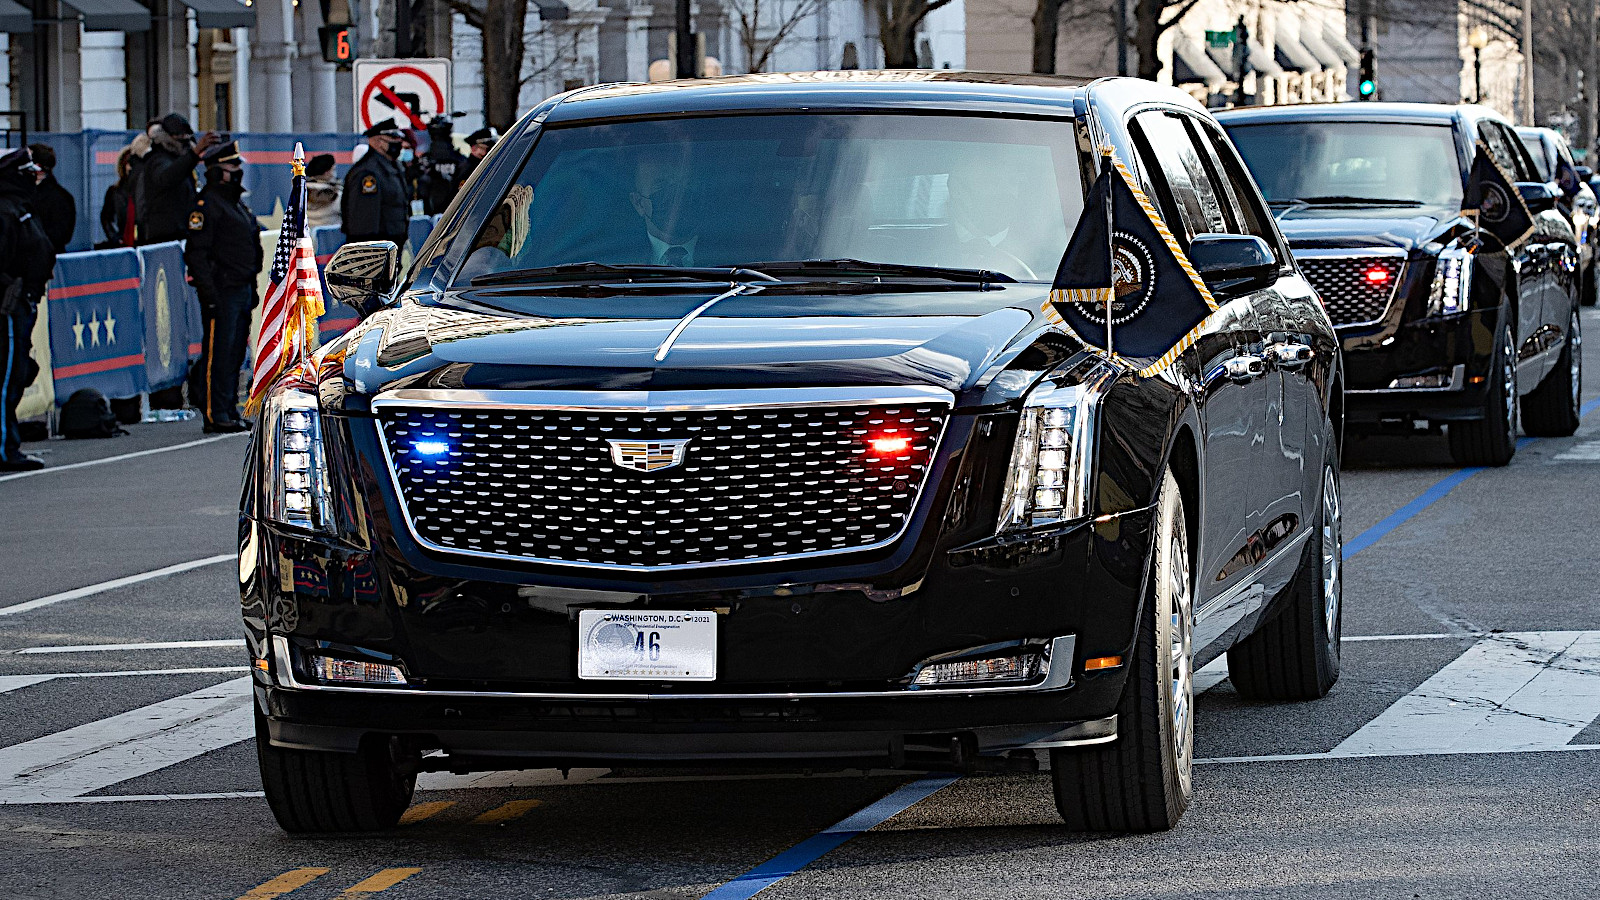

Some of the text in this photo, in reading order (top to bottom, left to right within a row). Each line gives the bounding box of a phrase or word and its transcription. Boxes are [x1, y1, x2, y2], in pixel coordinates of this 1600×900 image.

[337, 30, 350, 60] 6
[611, 614, 667, 622] WASHINGTON,
[668, 615, 684, 623] D.C.
[634, 631, 660, 661] 46
